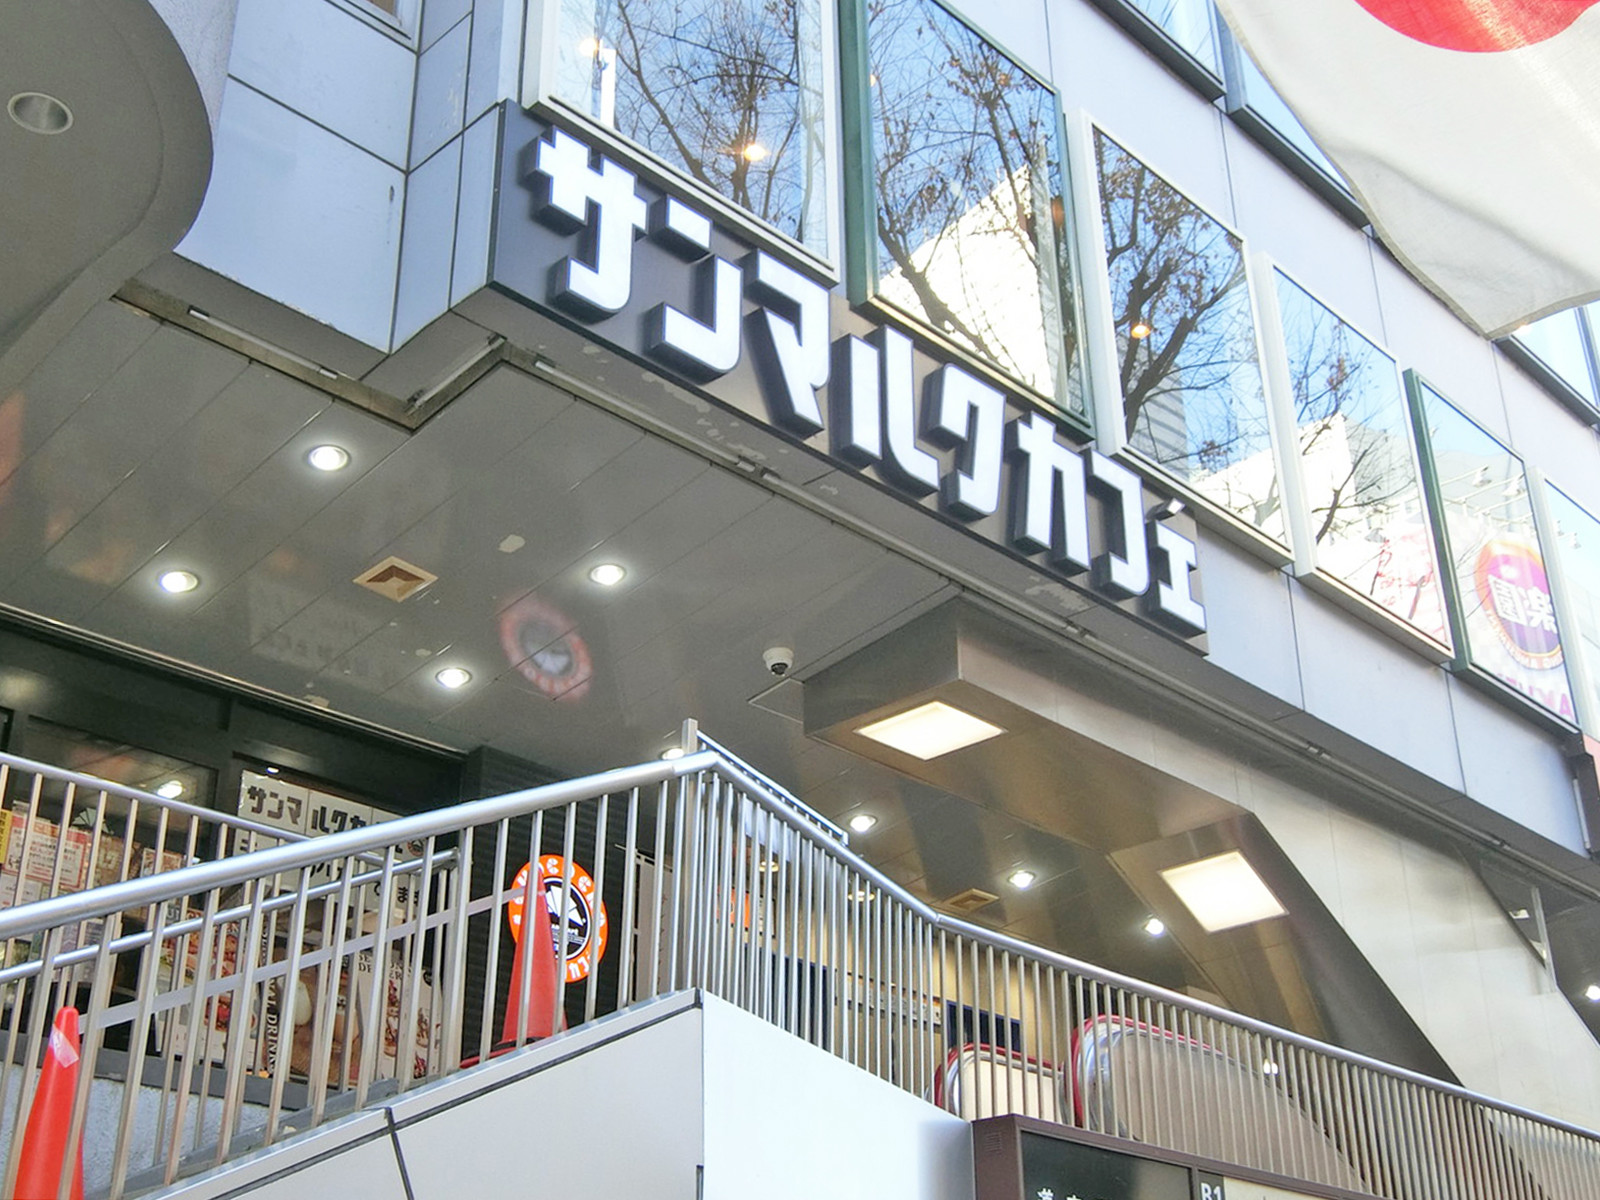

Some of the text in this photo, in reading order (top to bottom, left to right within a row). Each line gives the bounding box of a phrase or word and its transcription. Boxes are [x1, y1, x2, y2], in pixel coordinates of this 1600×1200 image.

[538, 128, 1207, 633] サンマルクカフェ
